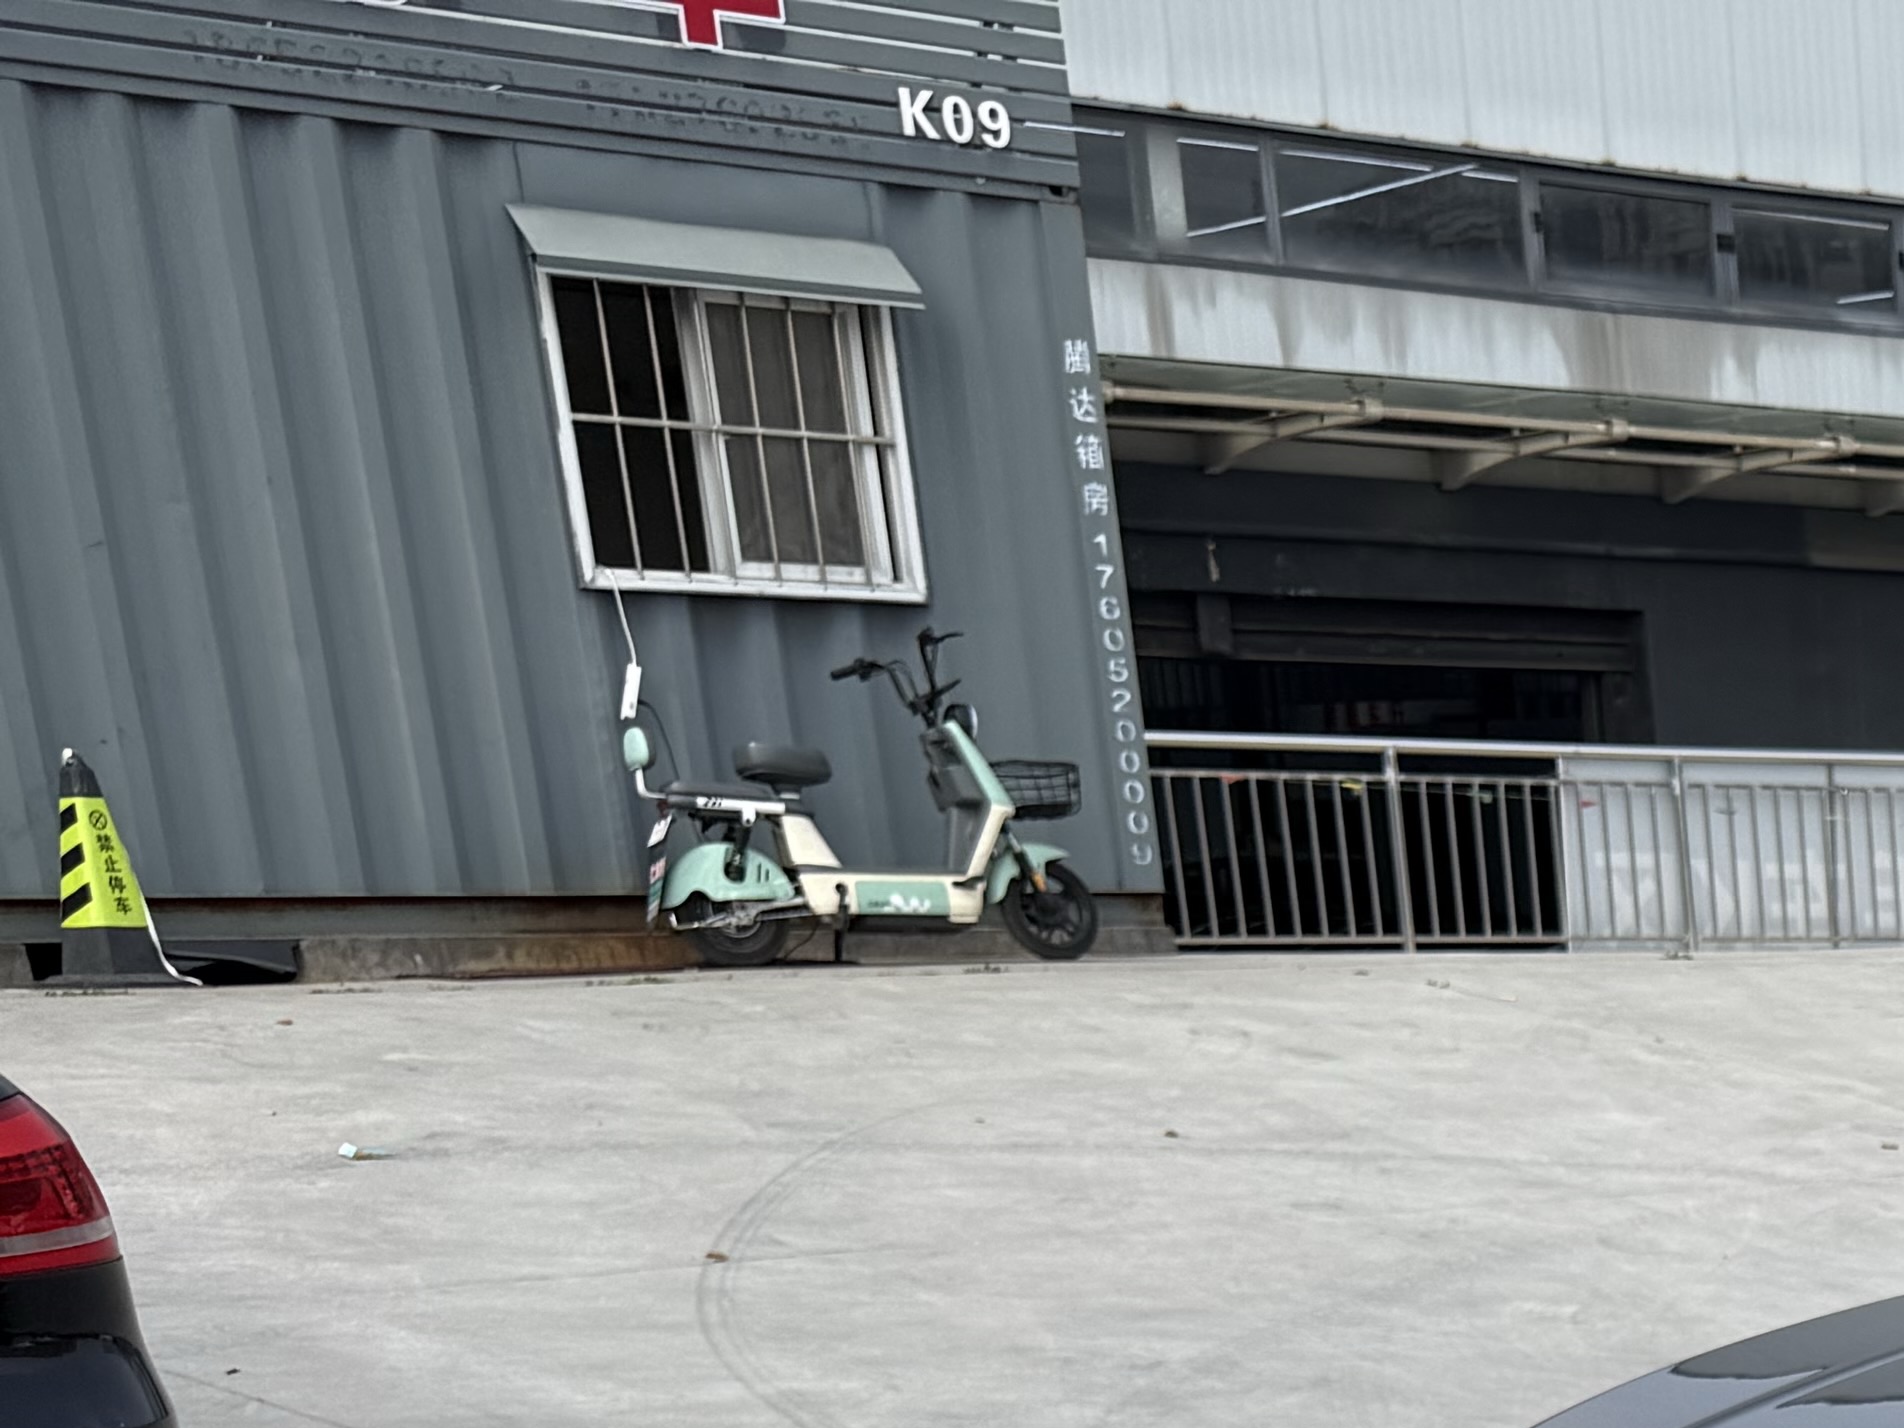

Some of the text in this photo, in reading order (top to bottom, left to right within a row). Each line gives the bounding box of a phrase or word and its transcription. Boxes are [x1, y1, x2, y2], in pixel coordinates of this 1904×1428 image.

[897, 87, 1011, 149] K09
[96, 834, 132, 915] 禁止停车
